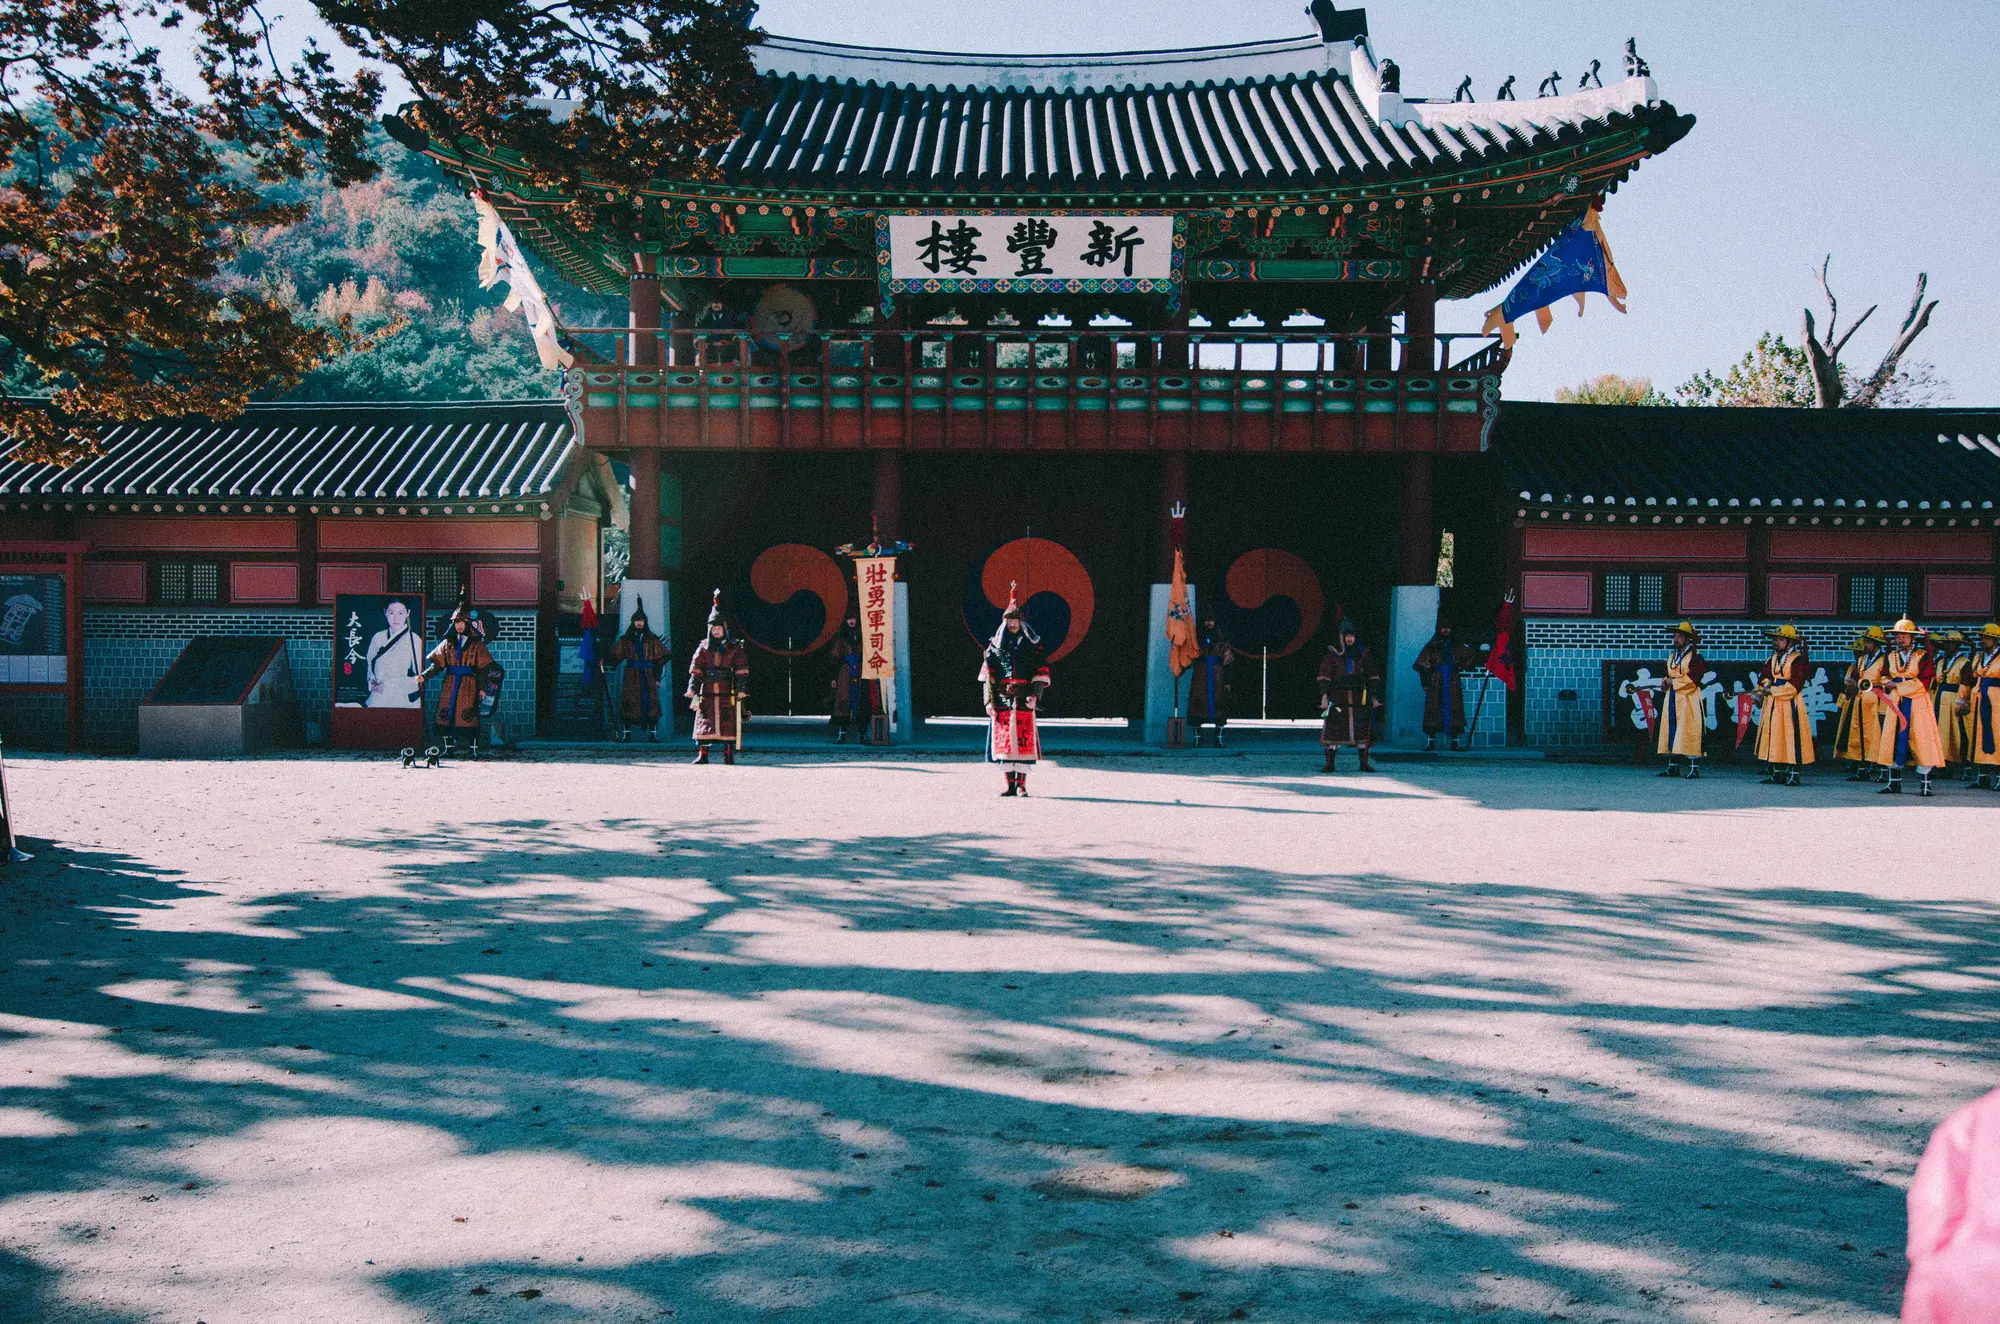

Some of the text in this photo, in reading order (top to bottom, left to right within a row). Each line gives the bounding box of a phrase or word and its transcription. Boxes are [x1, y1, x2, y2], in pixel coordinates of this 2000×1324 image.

[344, 611, 366, 665] 大長今
[865, 563, 888, 675] 壯勇軍司命
